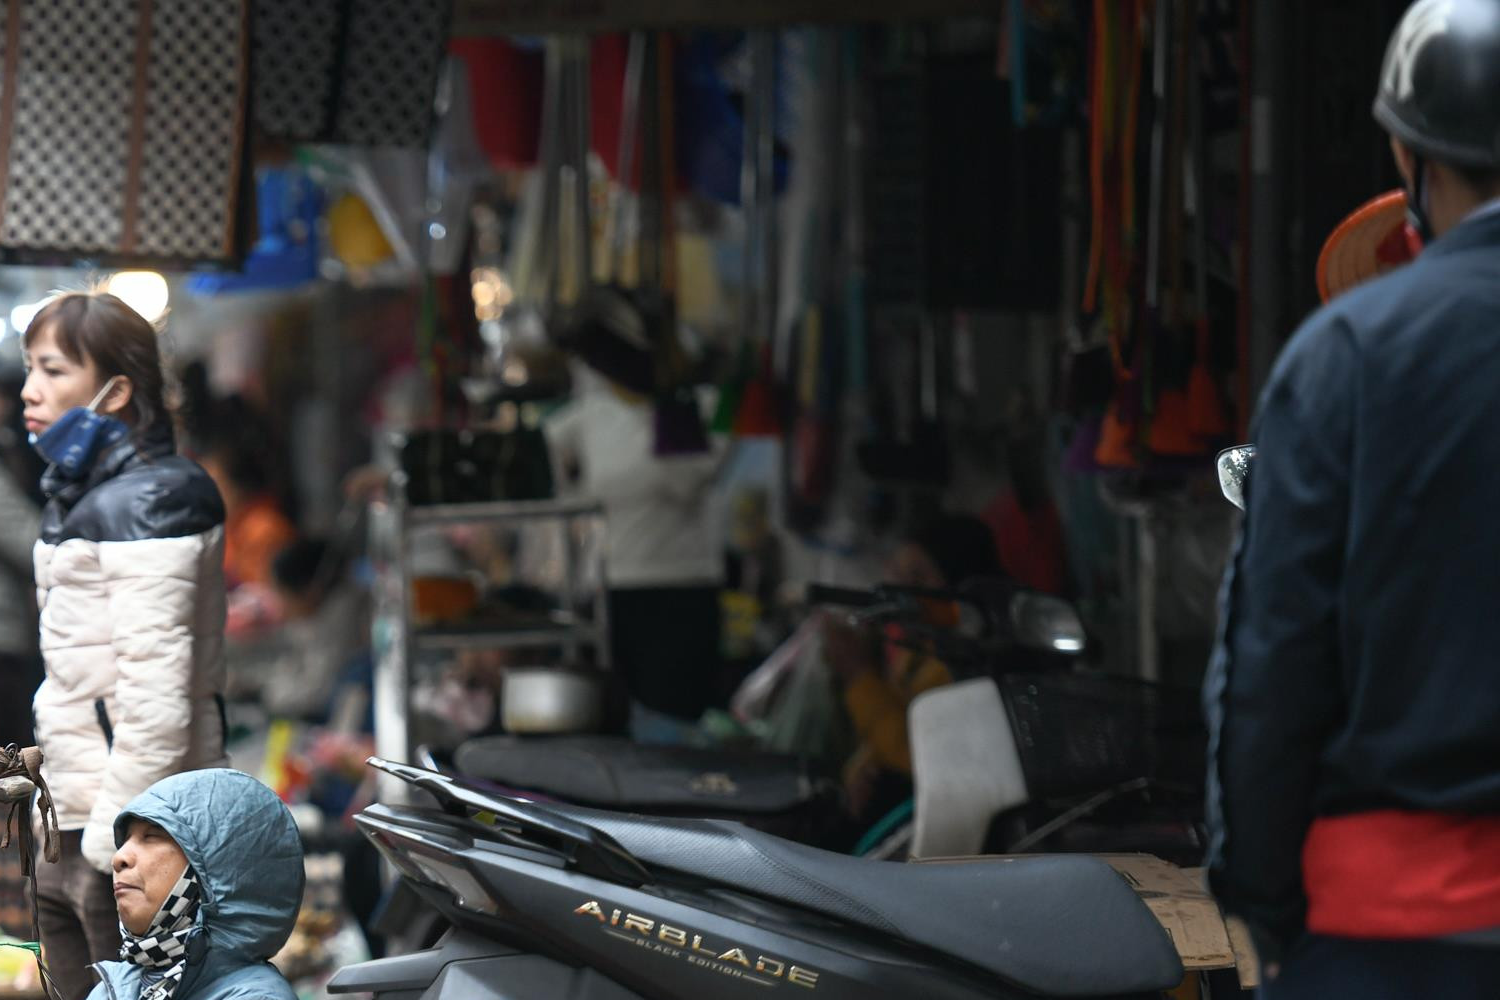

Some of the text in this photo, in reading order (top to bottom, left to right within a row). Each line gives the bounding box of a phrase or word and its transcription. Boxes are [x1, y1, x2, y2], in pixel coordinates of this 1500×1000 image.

[573, 900, 820, 989] AIRBLADE
[636, 939, 743, 977] BLACK EDITION
